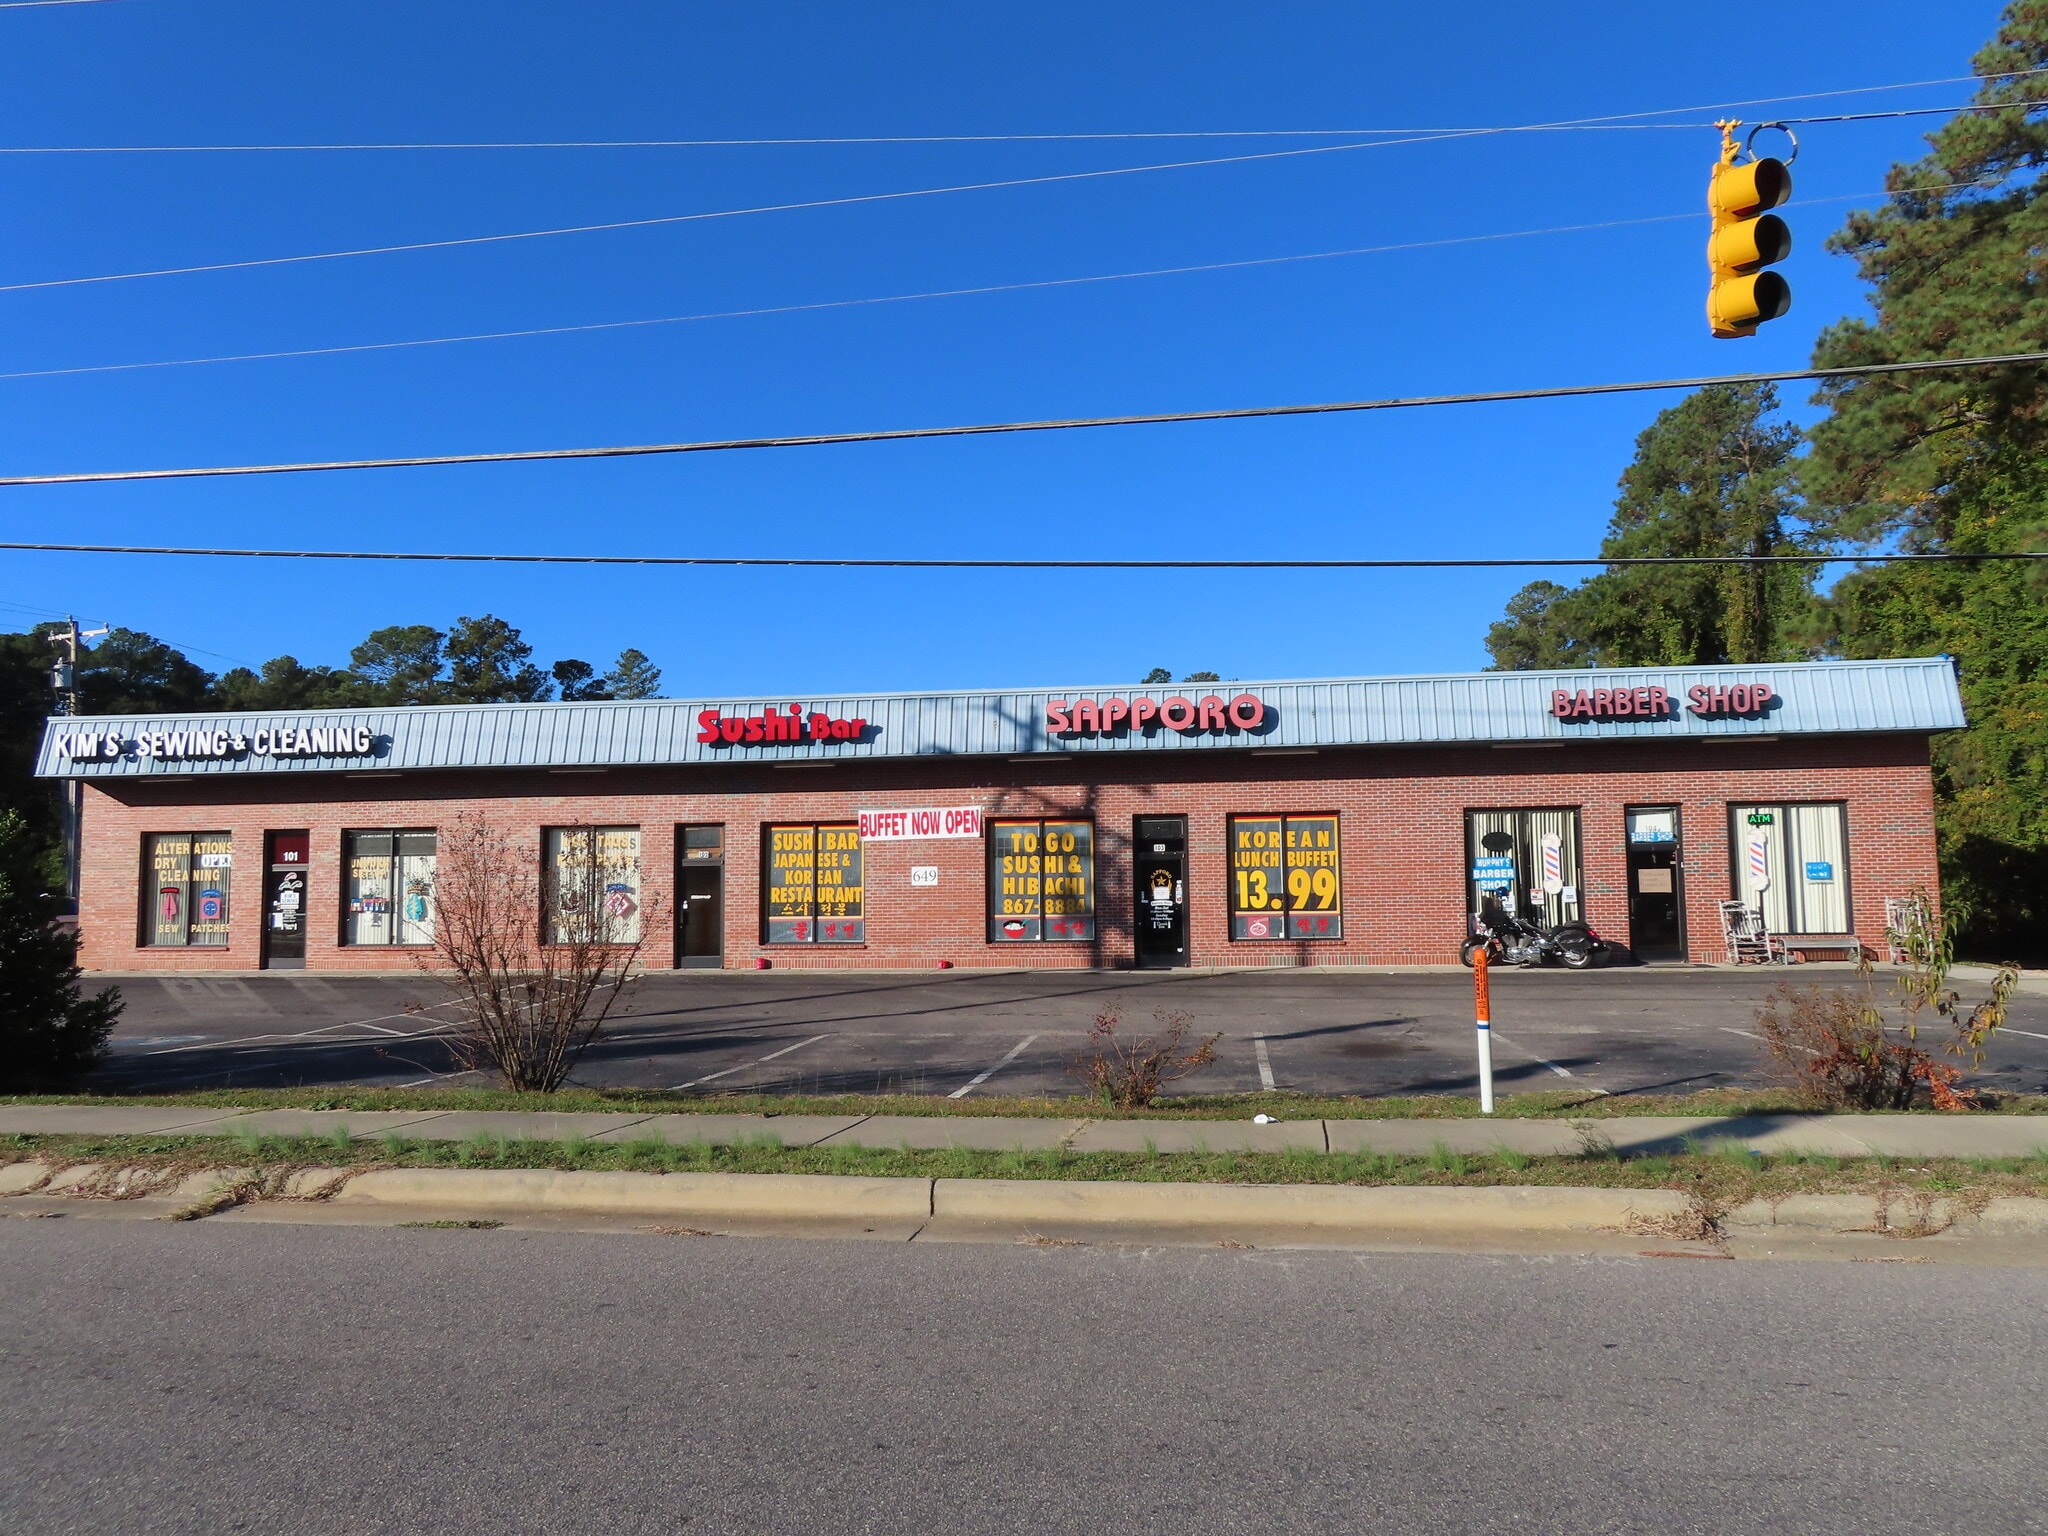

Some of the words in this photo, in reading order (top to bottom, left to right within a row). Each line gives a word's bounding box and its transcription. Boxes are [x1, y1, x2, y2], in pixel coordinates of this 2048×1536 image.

[1551, 685, 1670, 718] BARBER
[1688, 683, 1773, 714] SHOP
[1045, 693, 1264, 734] SAPPORO
[697, 702, 803, 744] Sushi
[809, 712, 867, 740] Bar
[54, 731, 120, 759] KIM'S
[136, 728, 229, 758] SEWING
[233, 733, 247, 751] &
[253, 725, 371, 756] CLEANING
[860, 812, 908, 838] BUFFET
[911, 811, 941, 836] NOW
[945, 809, 980, 835] OPEN
[1749, 815, 1771, 823] ATM
[773, 832, 823, 851] SUSHI
[826, 832, 859, 851] BAR
[1011, 832, 1038, 853] TO
[1045, 832, 1075, 853] GO
[1238, 830, 1330, 849] KOREAN
[155, 842, 233, 855] ALTERATIONS
[283, 851, 299, 862] 101
[154, 857, 178, 870] DRY
[773, 852, 839, 868] JAPANESE
[841, 853, 851, 867] &
[1002, 855, 1064, 874] SUSHI
[1068, 855, 1083, 874] &
[1234, 851, 1280, 868] LUNCH
[1287, 850, 1336, 868] BUFFET
[160, 869, 220, 882] CLEANING
[784, 869, 843, 885] KOREAN
[912, 869, 937, 882] 649
[1472, 868, 1515, 879] BARBER
[1002, 877, 1085, 896] HIBACHI
[1236, 868, 1336, 910] 13.99
[1480, 879, 1509, 890] SHOP
[770, 886, 863, 903] RESTAURANT
[158, 924, 180, 933] SEW
[191, 923, 231, 933] PATCHES
